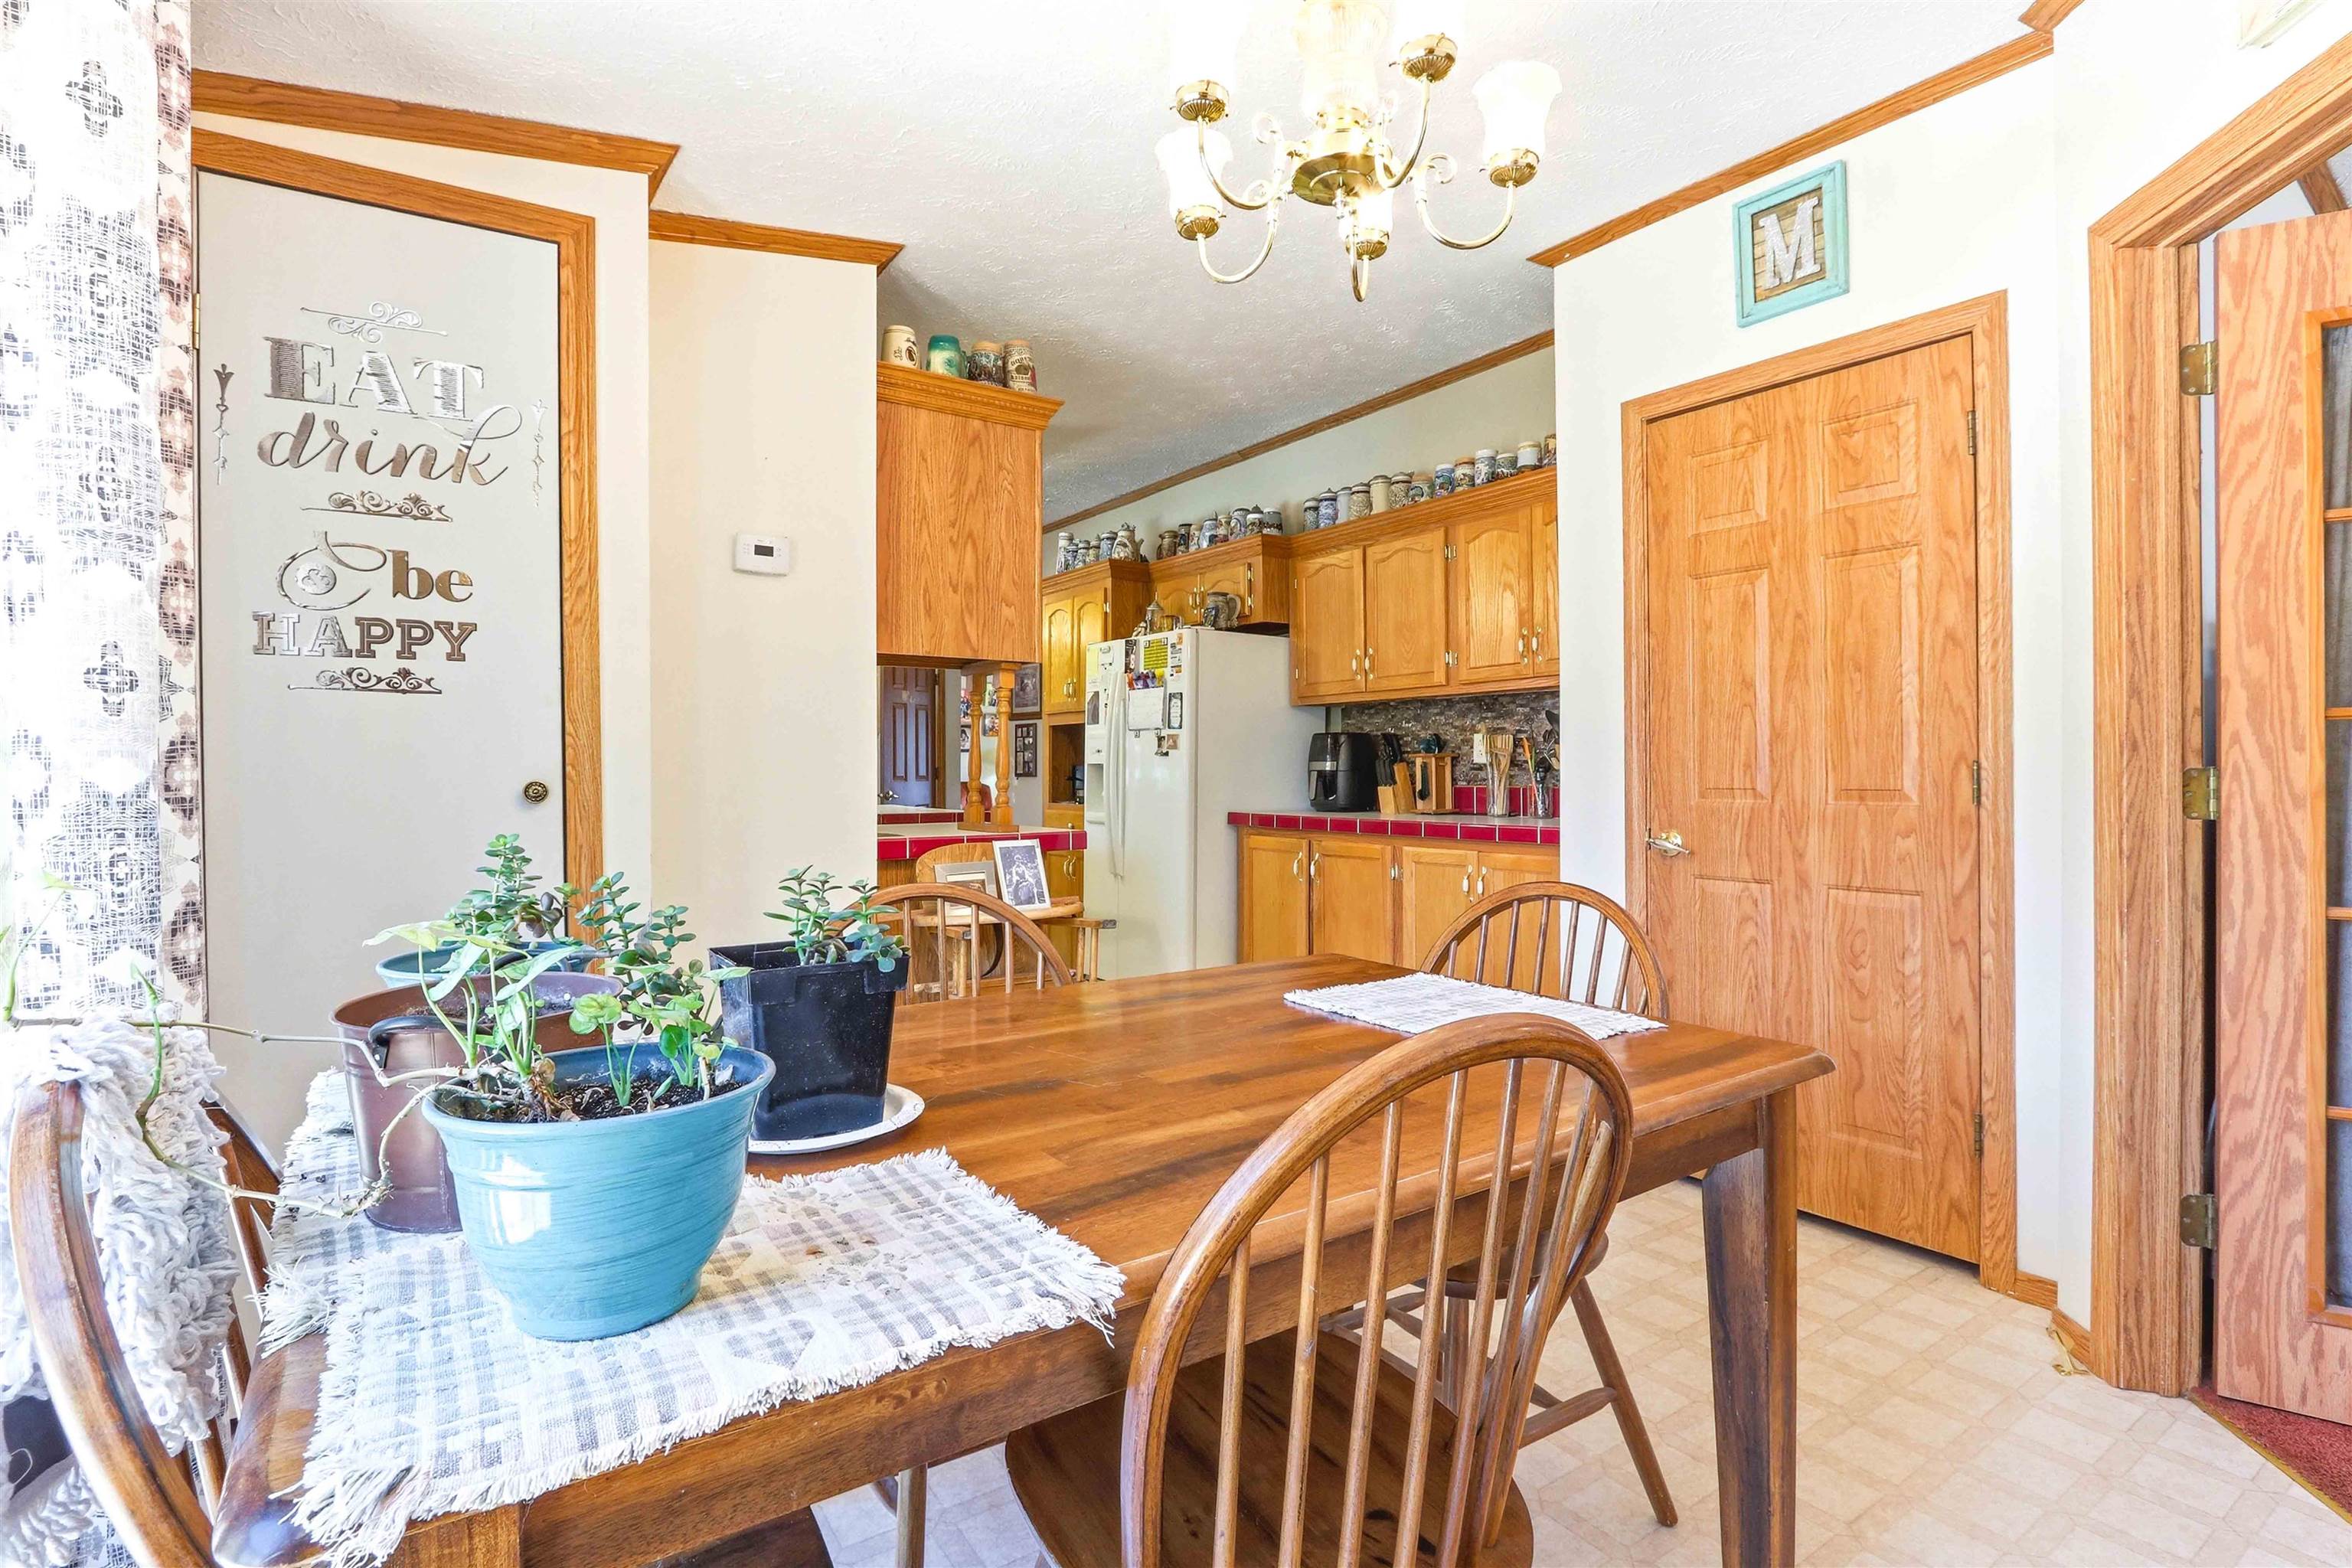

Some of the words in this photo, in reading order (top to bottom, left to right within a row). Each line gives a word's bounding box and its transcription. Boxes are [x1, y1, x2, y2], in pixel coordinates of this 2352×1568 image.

[1759, 197, 1821, 289] M
[263, 336, 485, 422] EAT
[257, 405, 522, 485] drink
[387, 549, 473, 602] be
[252, 611, 477, 662] HAPPY
